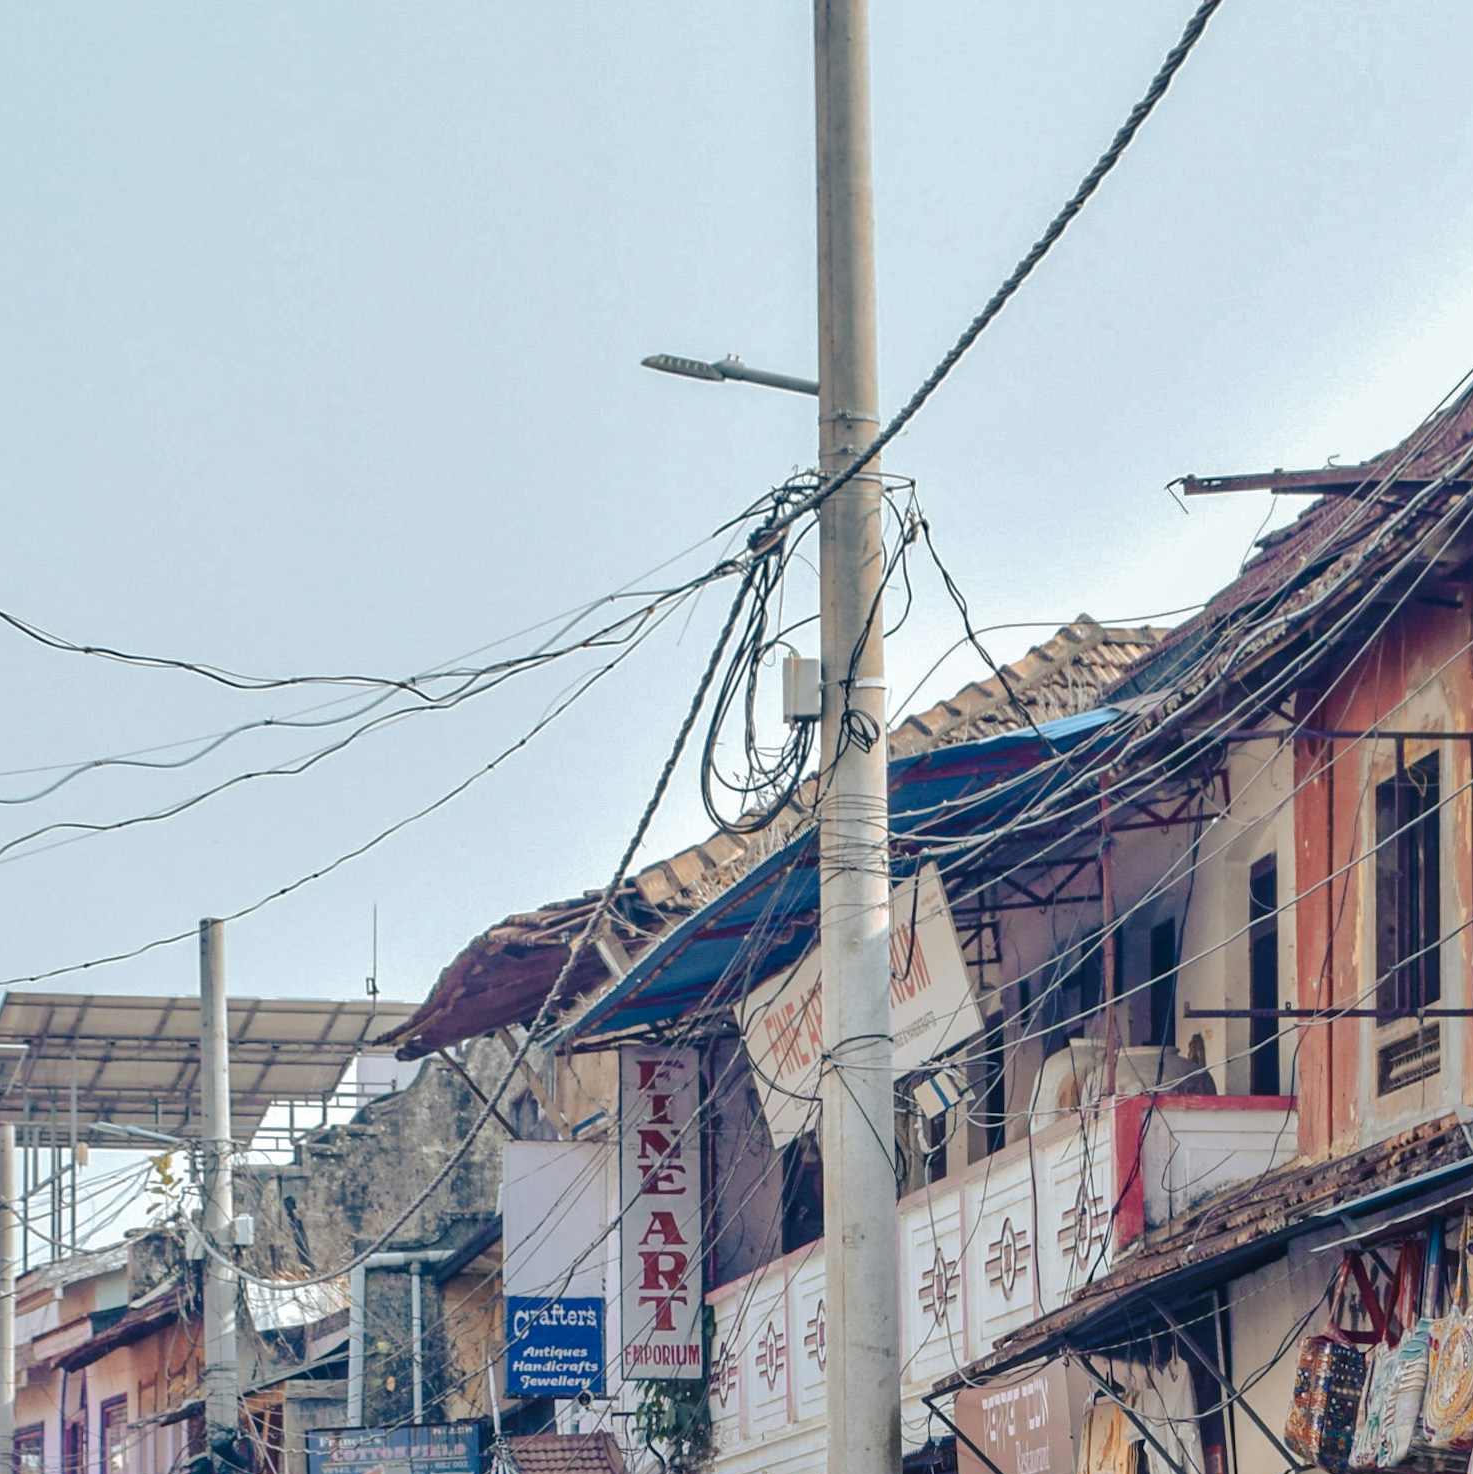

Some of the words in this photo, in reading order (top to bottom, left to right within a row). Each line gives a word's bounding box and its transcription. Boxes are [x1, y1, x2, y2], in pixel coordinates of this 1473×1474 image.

[635, 1060, 687, 1196] FINE
[638, 1211, 688, 1331] ART
[522, 1345, 589, 1360] Antiques
[625, 1344, 700, 1367] EMPORIUM
[512, 1360, 599, 1374] Handicrafts
[519, 1374, 592, 1390] Jewellery
